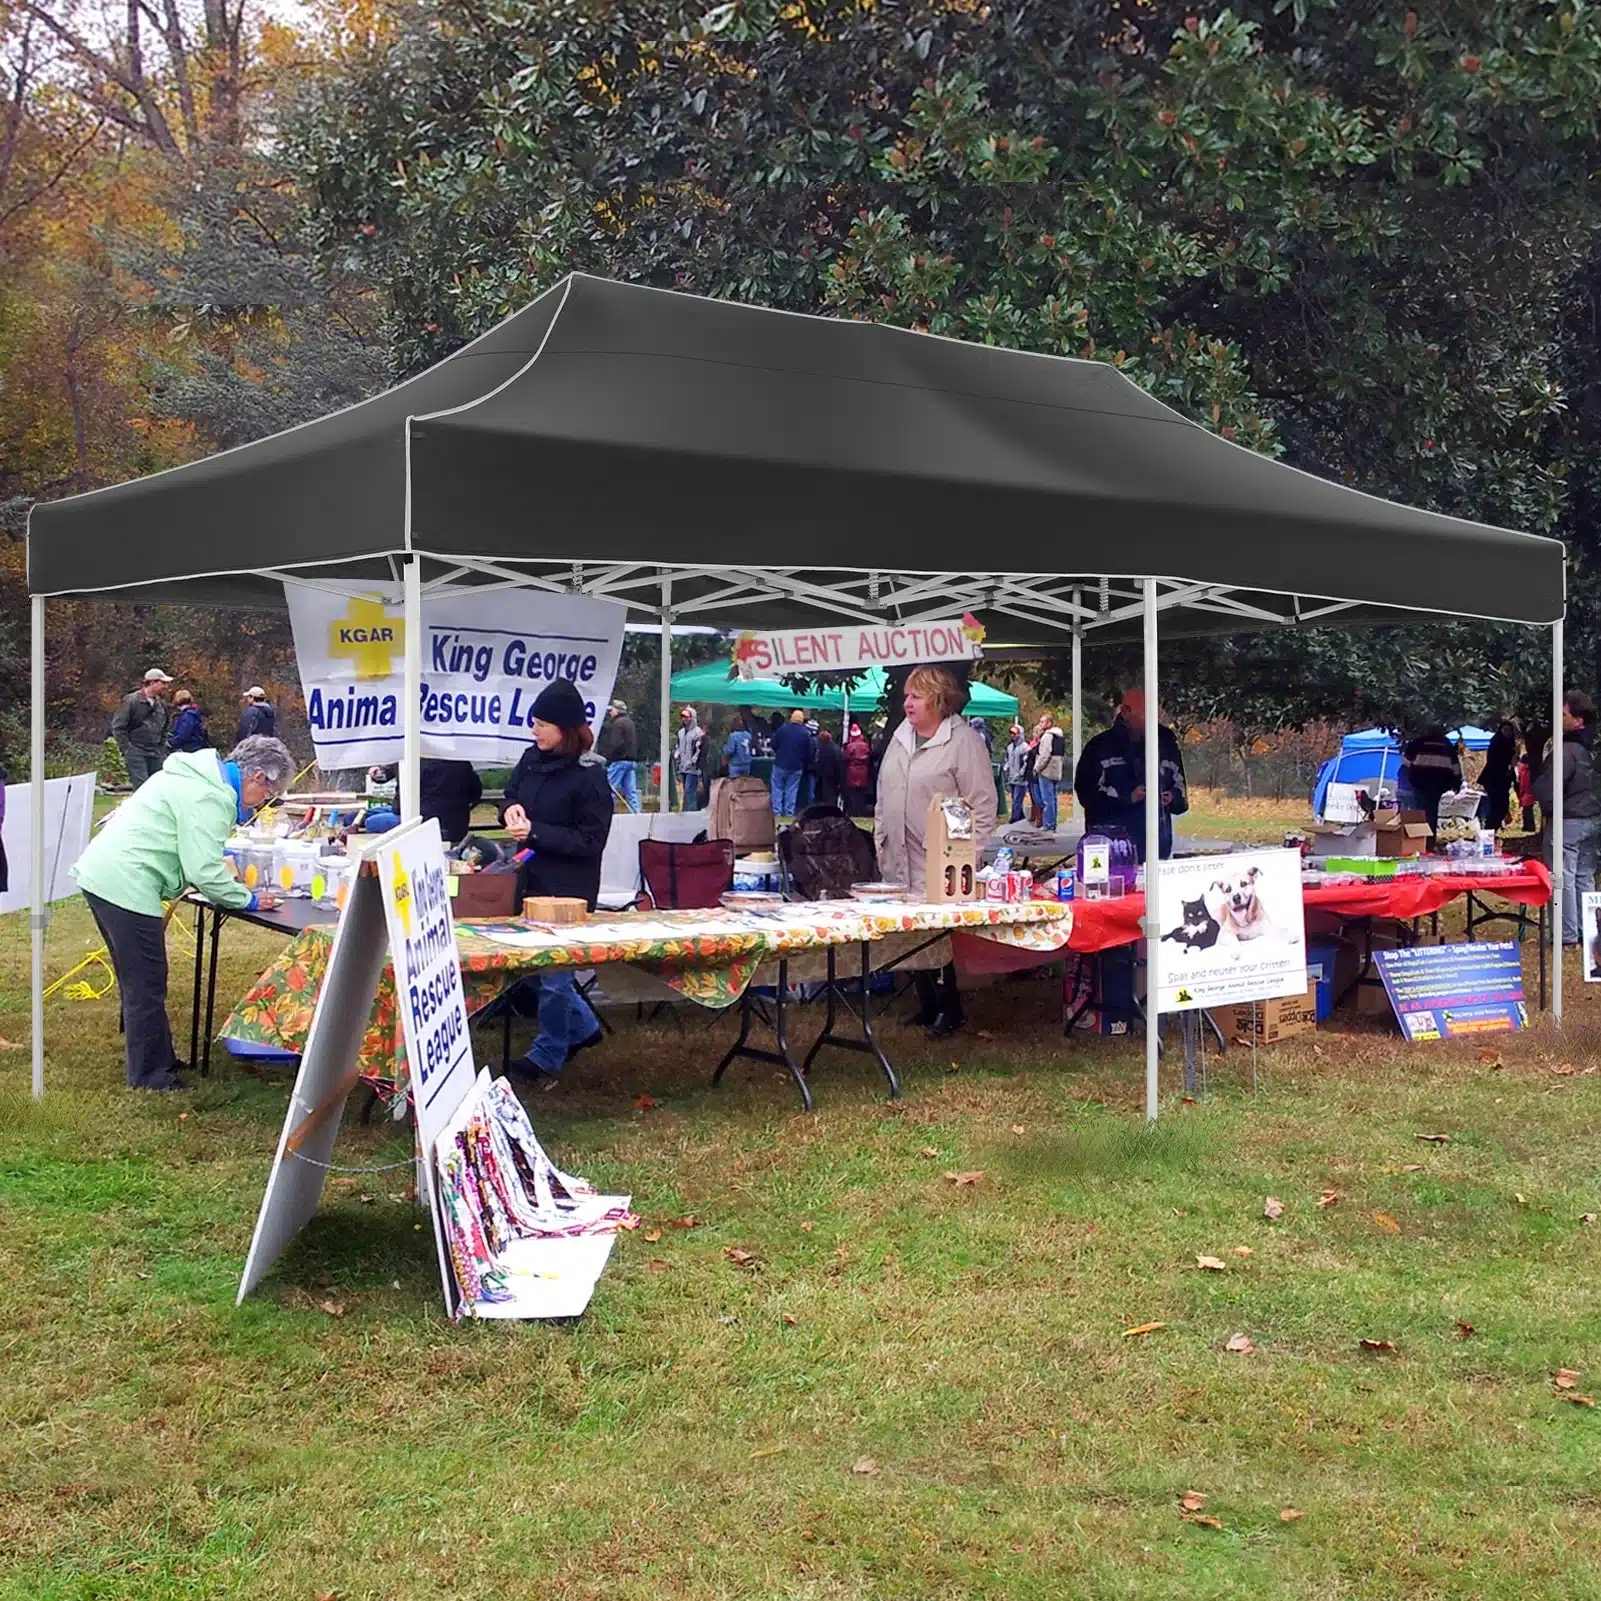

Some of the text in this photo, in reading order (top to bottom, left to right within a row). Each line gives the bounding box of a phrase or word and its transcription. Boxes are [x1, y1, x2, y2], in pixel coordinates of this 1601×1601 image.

[340, 628, 393, 643] KGAR
[432, 634, 597, 682] King George
[754, 627, 965, 669] SILENT AUCTION
[309, 686, 397, 729] Anima
[405, 904, 451, 986] Animal
[409, 959, 457, 1034] Rescue
[415, 1002, 463, 1085] League
